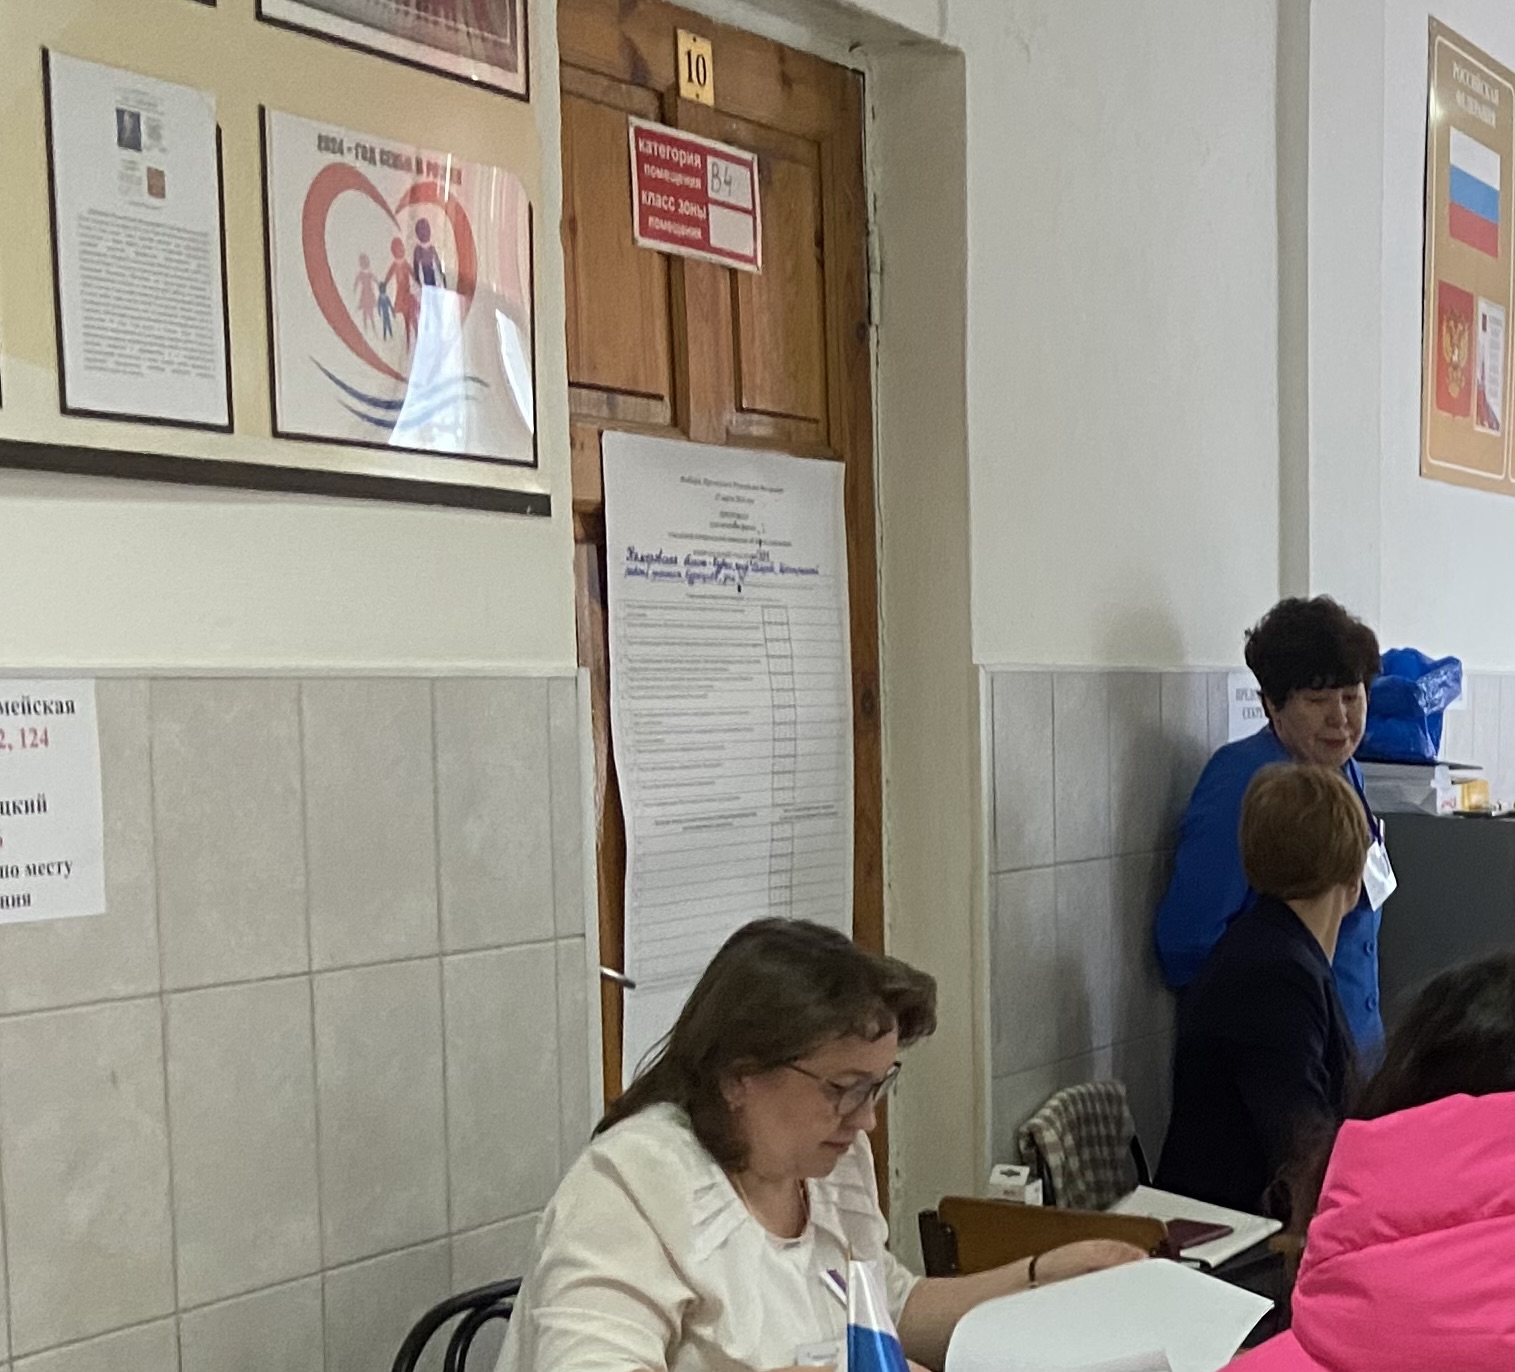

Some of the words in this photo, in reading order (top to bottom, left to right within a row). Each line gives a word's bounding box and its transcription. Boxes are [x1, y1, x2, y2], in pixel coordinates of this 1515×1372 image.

[684, 49, 707, 87] 10
[638, 137, 702, 168] категория
[641, 189, 676, 212] класс
[678, 198, 707, 220] зоны
[20, 726, 50, 749] 124
[25, 860, 73, 880] месту
